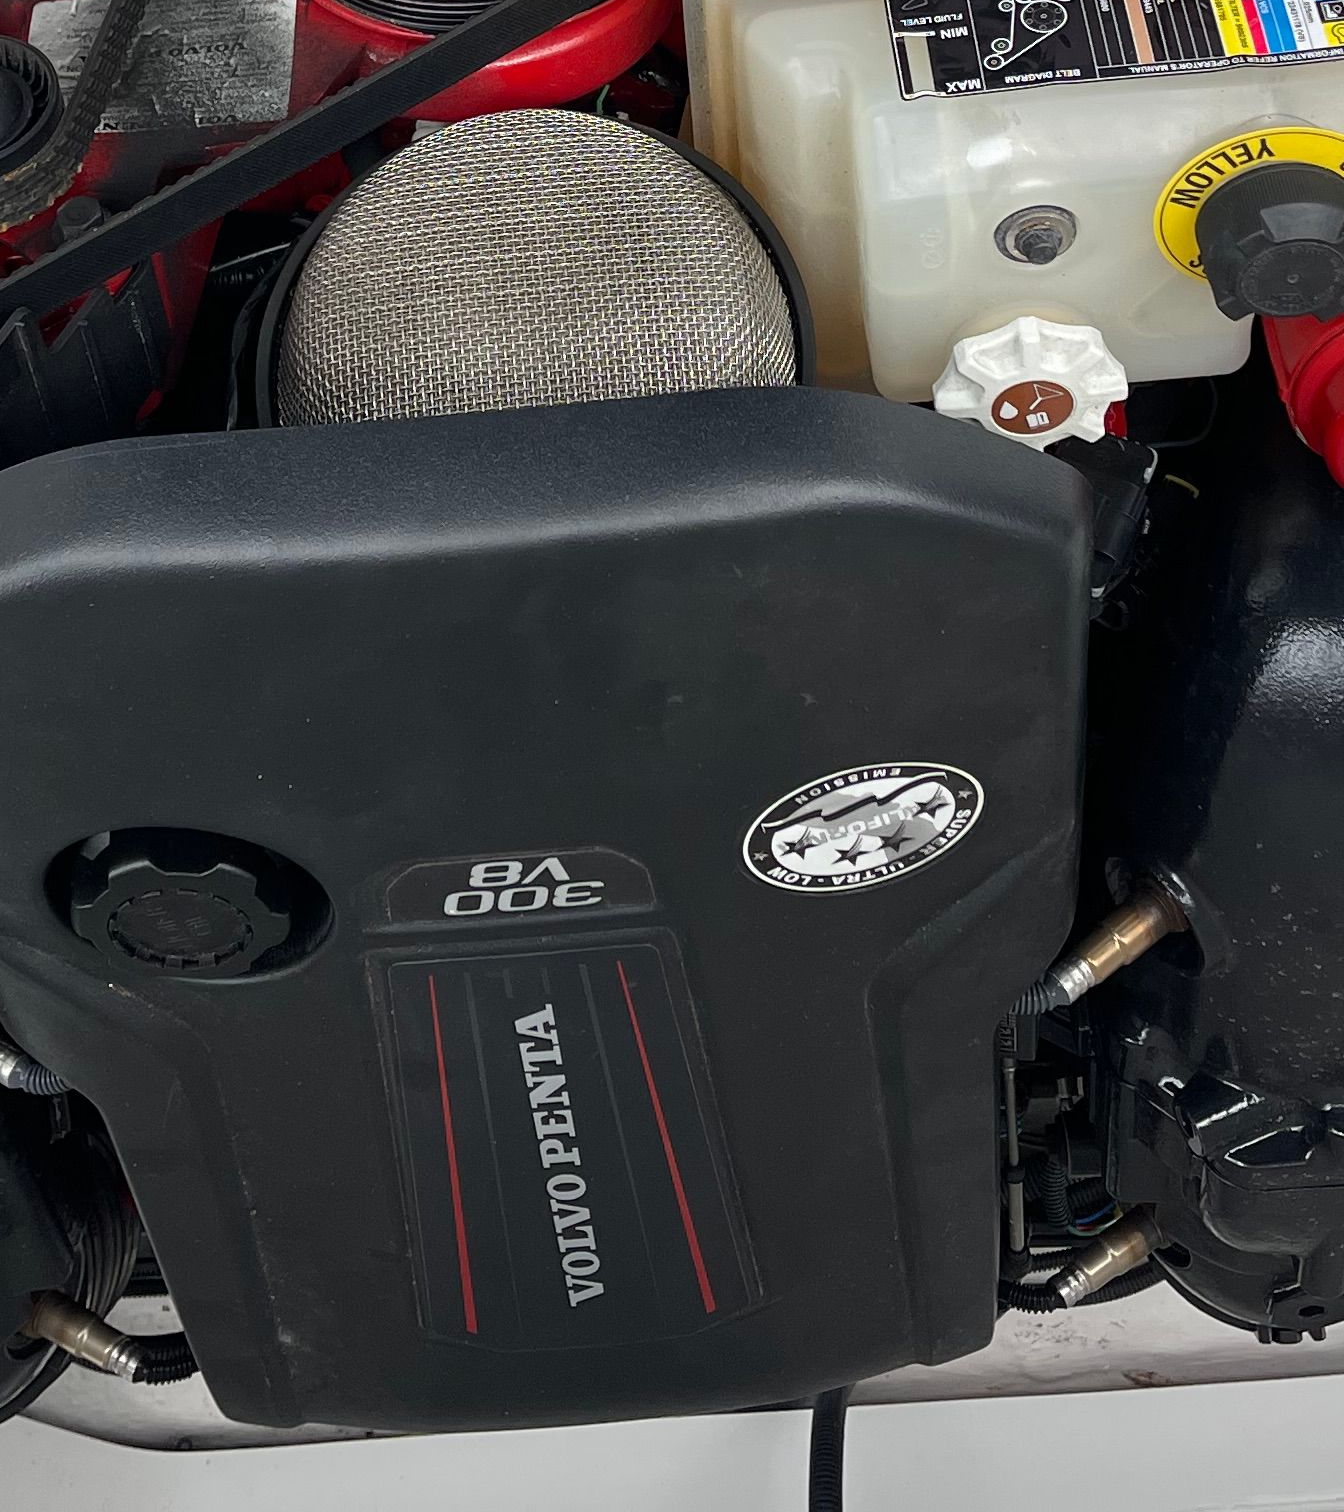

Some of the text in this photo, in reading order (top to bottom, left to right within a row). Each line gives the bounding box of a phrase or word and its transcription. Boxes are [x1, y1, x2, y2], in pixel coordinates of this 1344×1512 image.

[899, 12, 963, 26] FLUID LEVEL
[939, 25, 968, 38] MIN
[1230, 56, 1245, 64] TO
[1246, 53, 1277, 64] REFER
[1277, 47, 1344, 61] INFORMATION
[1128, 63, 1168, 73] MANUAL
[1169, 58, 1231, 71] OPERATOR'S
[1004, 68, 1081, 83] BELT DIAGRAM
[944, 78, 981, 92] MAX
[1172, 138, 1275, 209] YELLOW
[794, 767, 902, 805] EMISSION
[768, 808, 974, 886] SUPER ULTRA LOW
[469, 857, 571, 888] V8
[443, 879, 605, 916] 300
[514, 1003, 604, 1307] VOLVO PENTA
